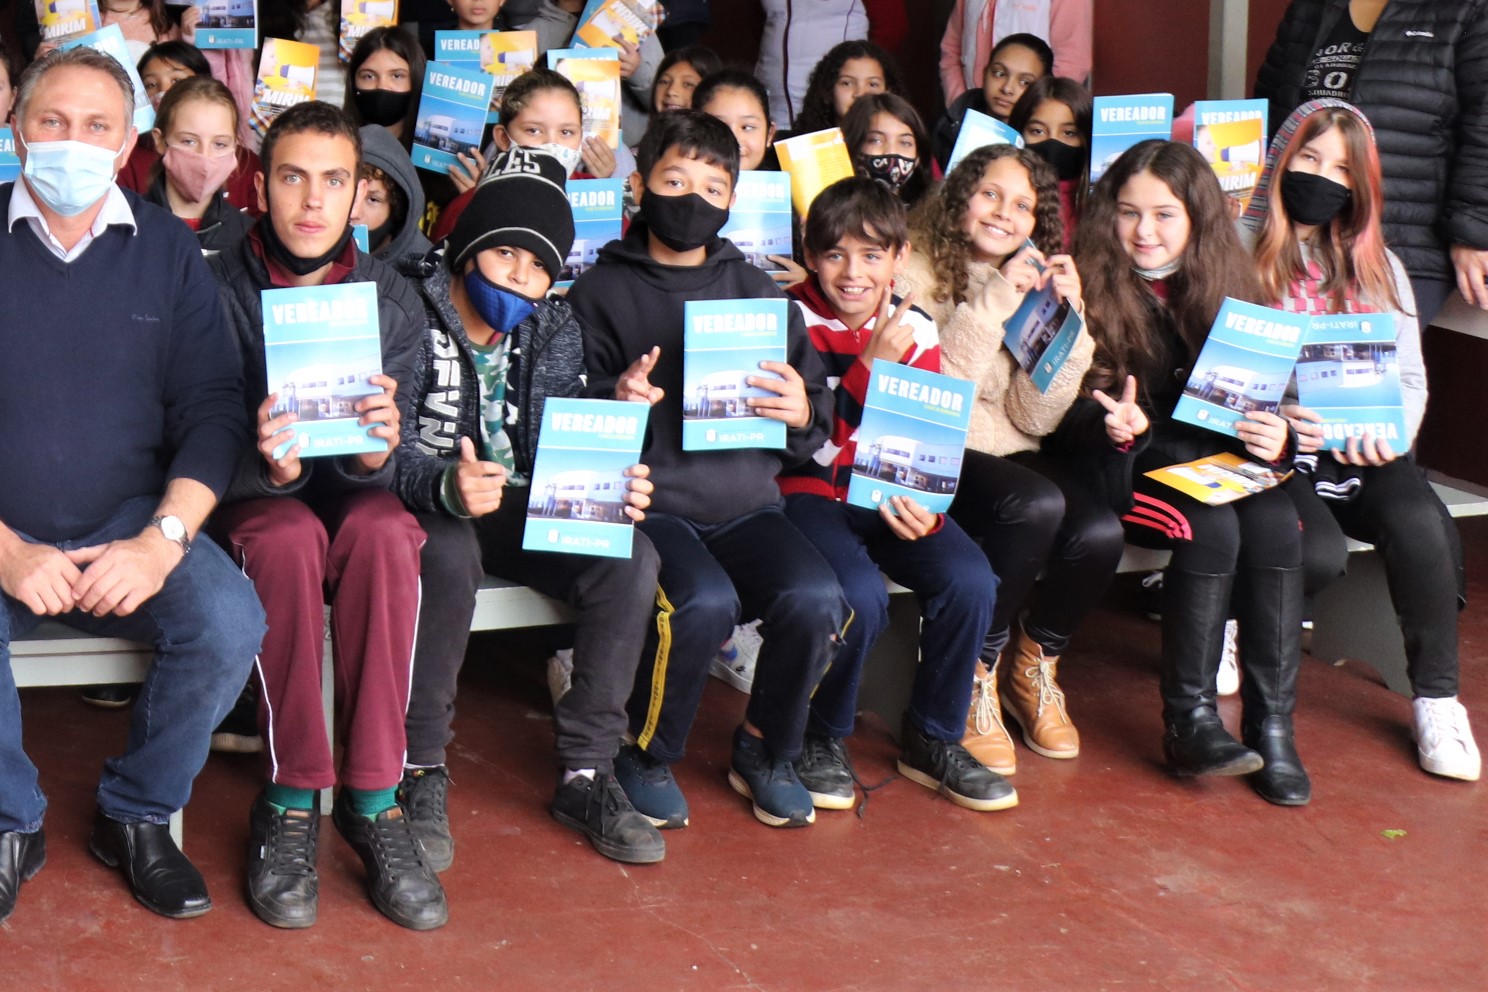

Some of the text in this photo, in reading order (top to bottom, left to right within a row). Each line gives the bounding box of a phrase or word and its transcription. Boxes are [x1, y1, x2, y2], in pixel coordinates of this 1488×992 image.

[45, 19, 86, 39] MIRIM
[441, 39, 480, 51] VEREAD
[429, 71, 485, 95] VEREADOR
[1100, 106, 1167, 122] VEREADOR
[567, 190, 615, 208] EADOR
[272, 300, 369, 325] VEREADOR
[693, 313, 778, 334] VEREADOR
[1225, 311, 1301, 343] VEREADOR
[878, 374, 964, 412] VEREADOR
[552, 411, 638, 436] VEREADOR
[313, 435, 364, 448] IRATI-PR
[719, 432, 765, 444] IRATI-PR
[561, 534, 610, 551] IRATI-PR
